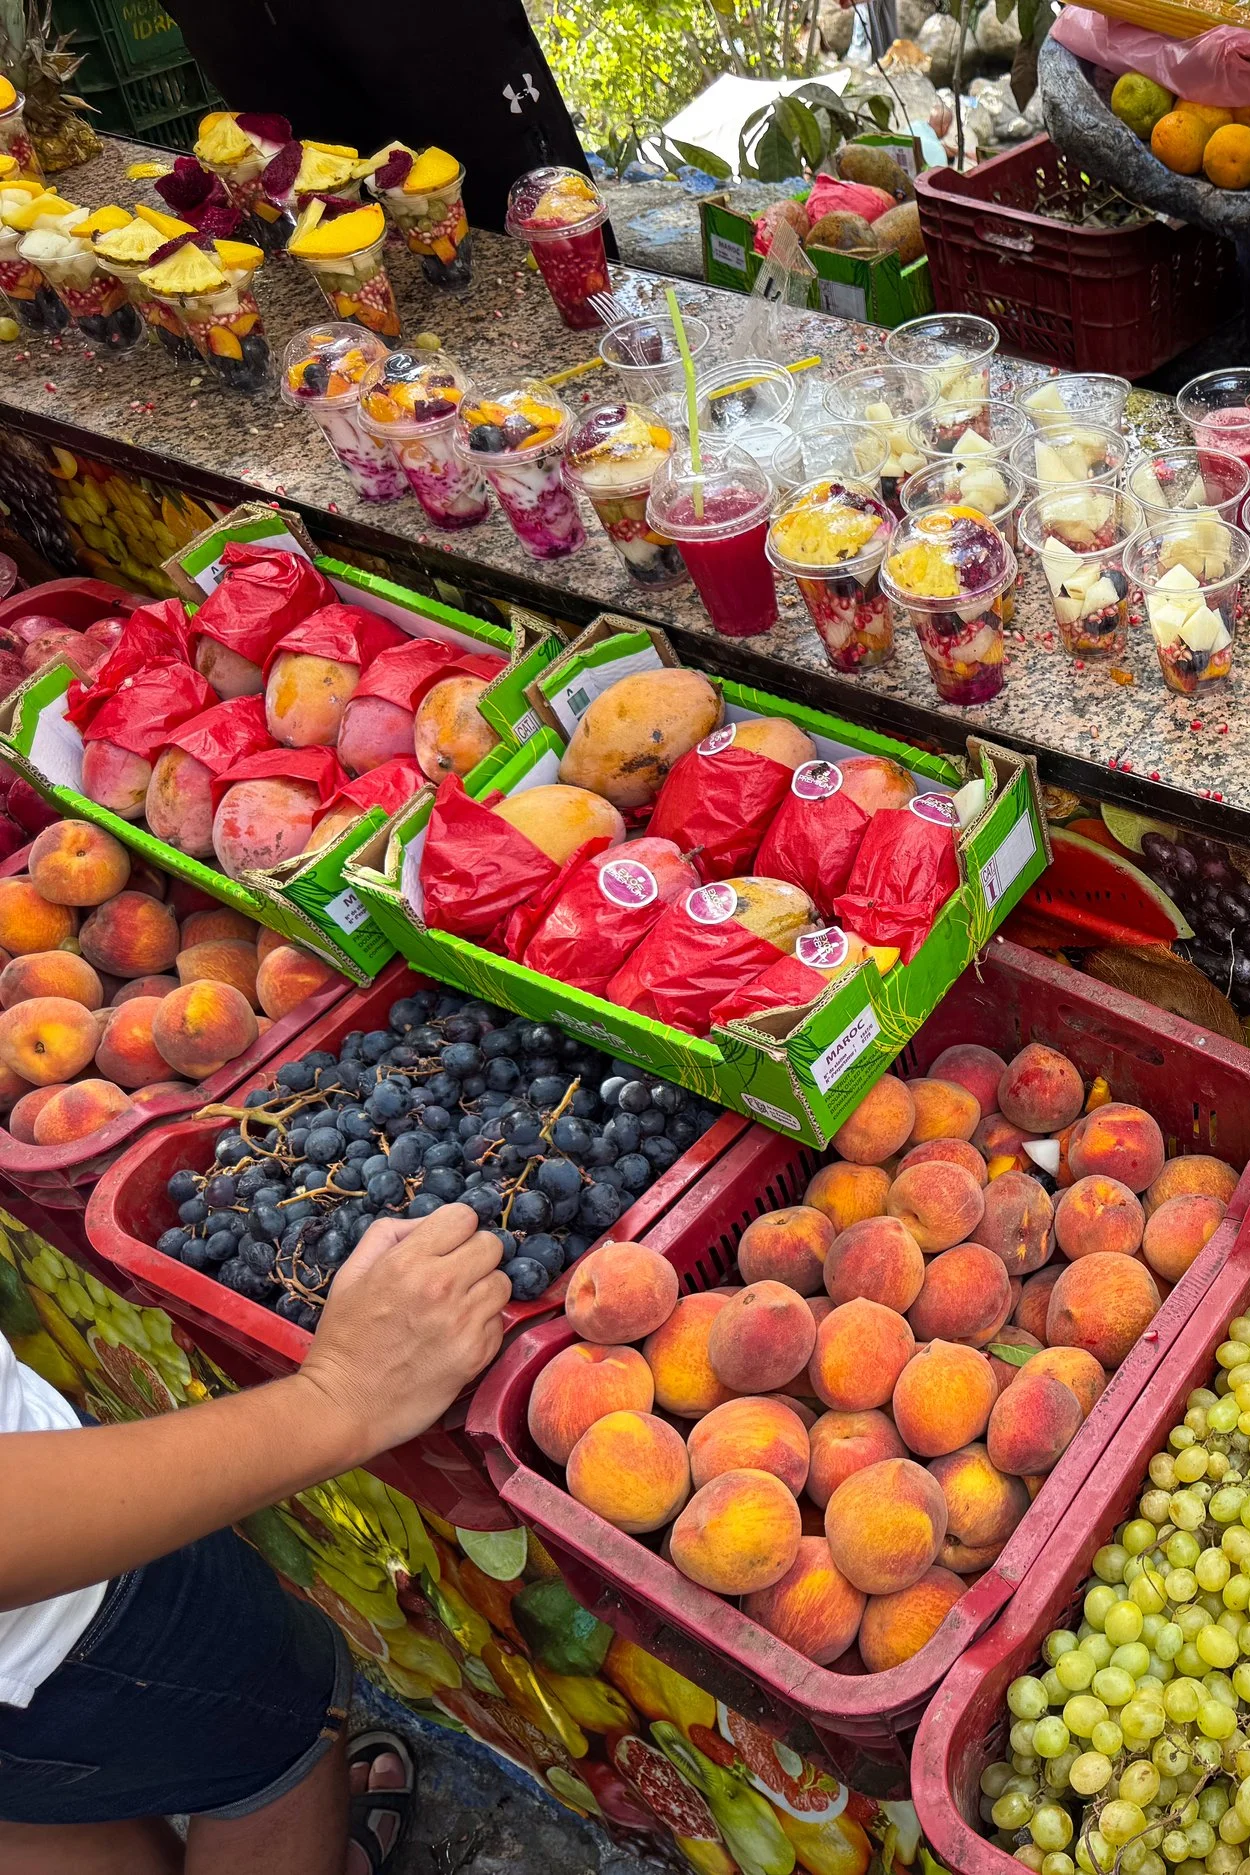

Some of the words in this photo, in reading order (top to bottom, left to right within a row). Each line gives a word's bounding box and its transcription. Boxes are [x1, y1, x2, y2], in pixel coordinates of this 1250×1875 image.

[797, 774, 834, 791] PREMIUM
[804, 769, 831, 783] EOS
[617, 867, 646, 891] EXOS
[825, 1018, 866, 1065] MAROC
